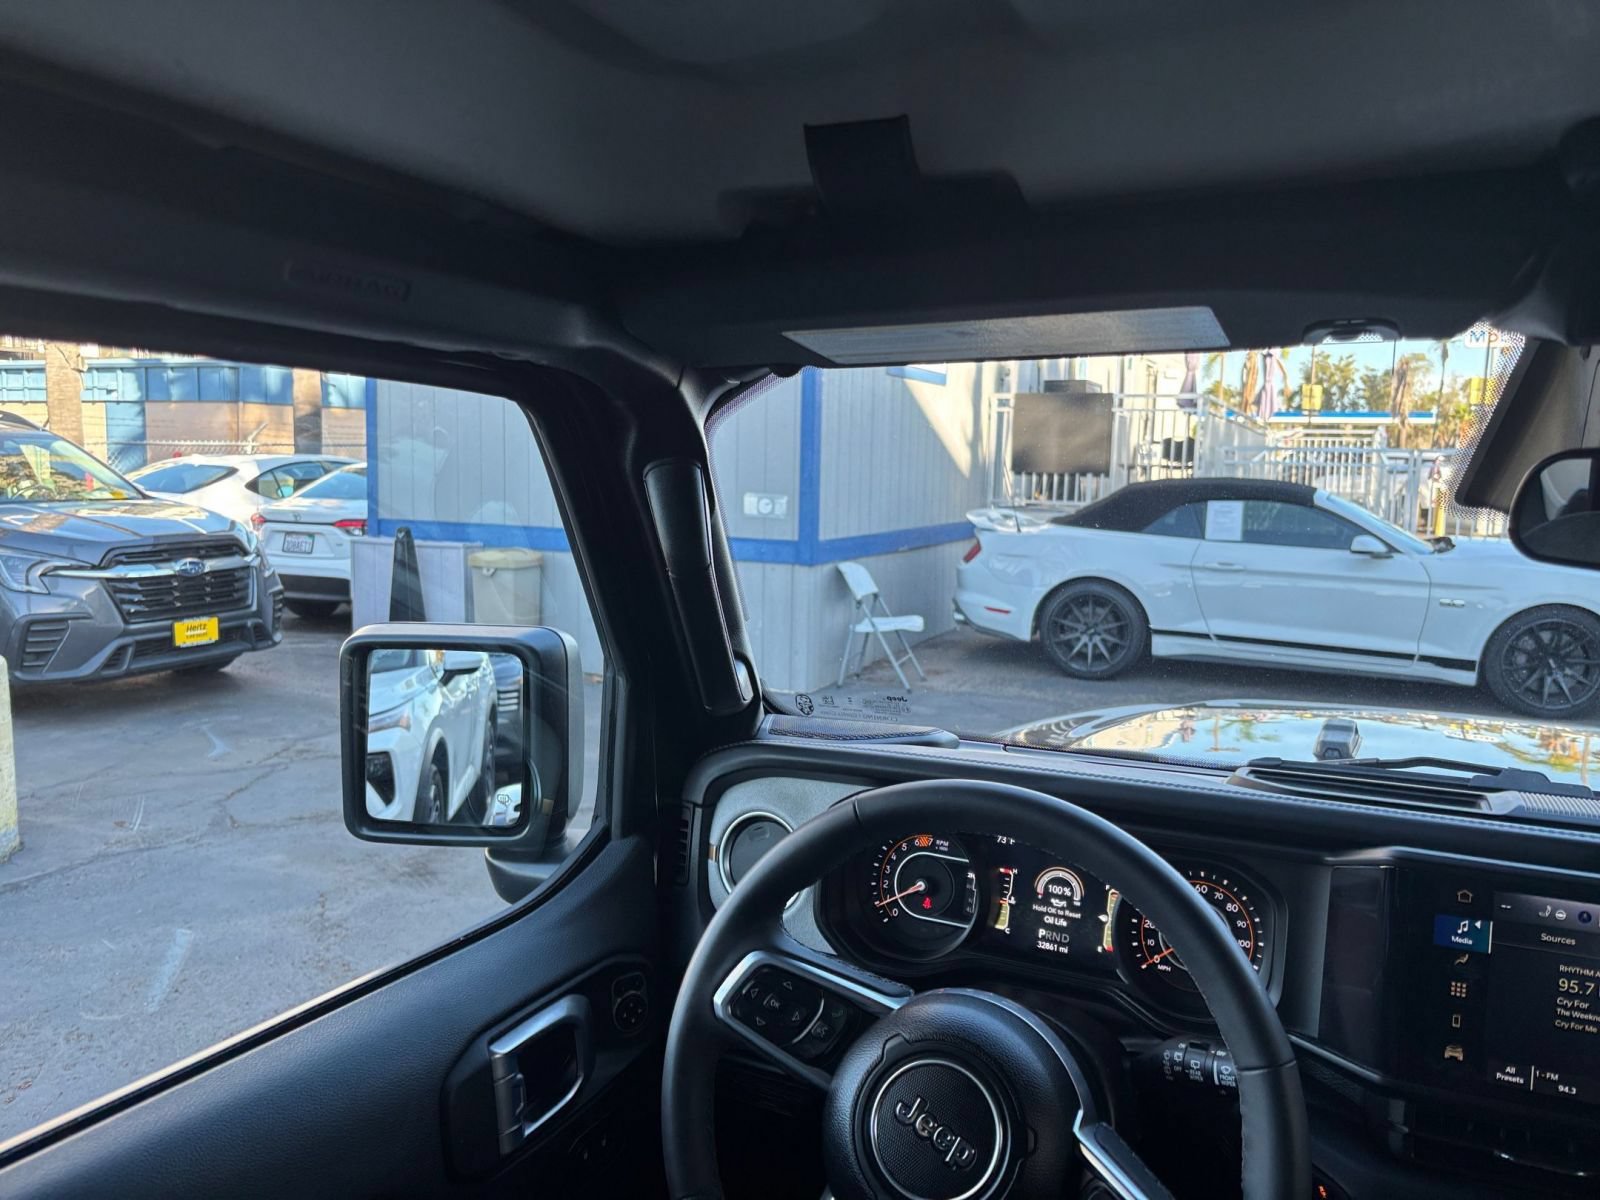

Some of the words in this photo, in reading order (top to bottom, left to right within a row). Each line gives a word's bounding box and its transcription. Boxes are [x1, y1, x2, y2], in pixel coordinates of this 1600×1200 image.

[901, 842, 908, 851] 5
[936, 839, 949, 847] RPM
[891, 852, 897, 860] 4
[884, 865, 891, 874] 3
[882, 880, 889, 888] 2
[1195, 884, 1208, 894] 60
[1213, 891, 1224, 900] 70
[892, 908, 899, 916] 0
[1032, 903, 1047, 913] Hold
[1047, 906, 1057, 914] OK
[1064, 910, 1081, 919] Reset
[1226, 903, 1239, 913] 80
[1043, 915, 1054, 924] Oil
[1054, 918, 1068, 927] Life
[1236, 920, 1247, 928] 90
[1451, 935, 1473, 945] Media
[1540, 932, 1576, 946] Sources
[1036, 941, 1058, 952] 32861
[1058, 945, 1069, 954] mi
[1153, 954, 1160, 963] 0
[1157, 964, 1172, 972] MPH
[1559, 964, 1594, 977] RHYTHM
[1558, 978, 1595, 995] 95.7
[1556, 996, 1573, 1008] Cry
[1574, 999, 1590, 1009] For
[1556, 1007, 1571, 1017] The
[1554, 1019, 1570, 1030] Cry
[1570, 1022, 1583, 1031] For
[1585, 1025, 1598, 1033] Me
[1505, 1066, 1516, 1074] All
[1496, 1072, 1524, 1084] Presets
[1546, 1072, 1559, 1081] FM
[1558, 1084, 1577, 1095] 94.3
[894, 1096, 977, 1172] Jeep
